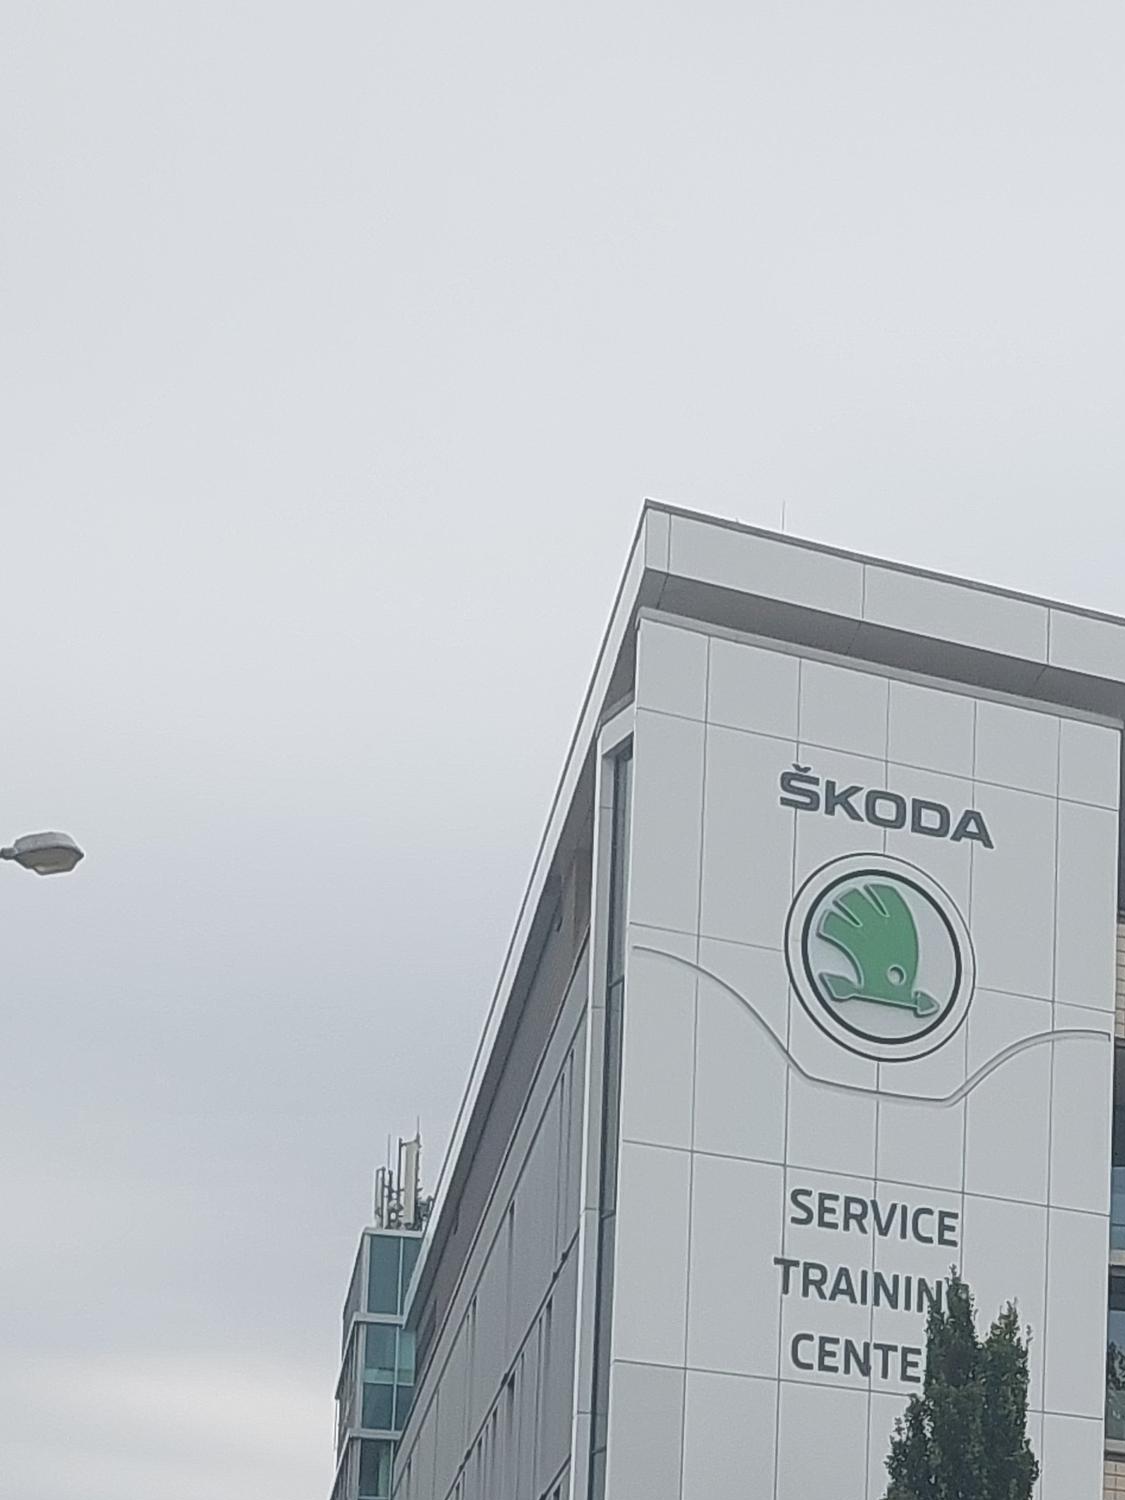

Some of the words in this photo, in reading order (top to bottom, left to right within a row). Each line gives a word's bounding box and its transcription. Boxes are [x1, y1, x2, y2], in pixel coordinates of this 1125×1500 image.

[779, 763, 995, 849] ŠKODA
[790, 1188, 960, 1248] SERVICE
[773, 1256, 943, 1314] TRAININ
[790, 1332, 923, 1384] CENTE
